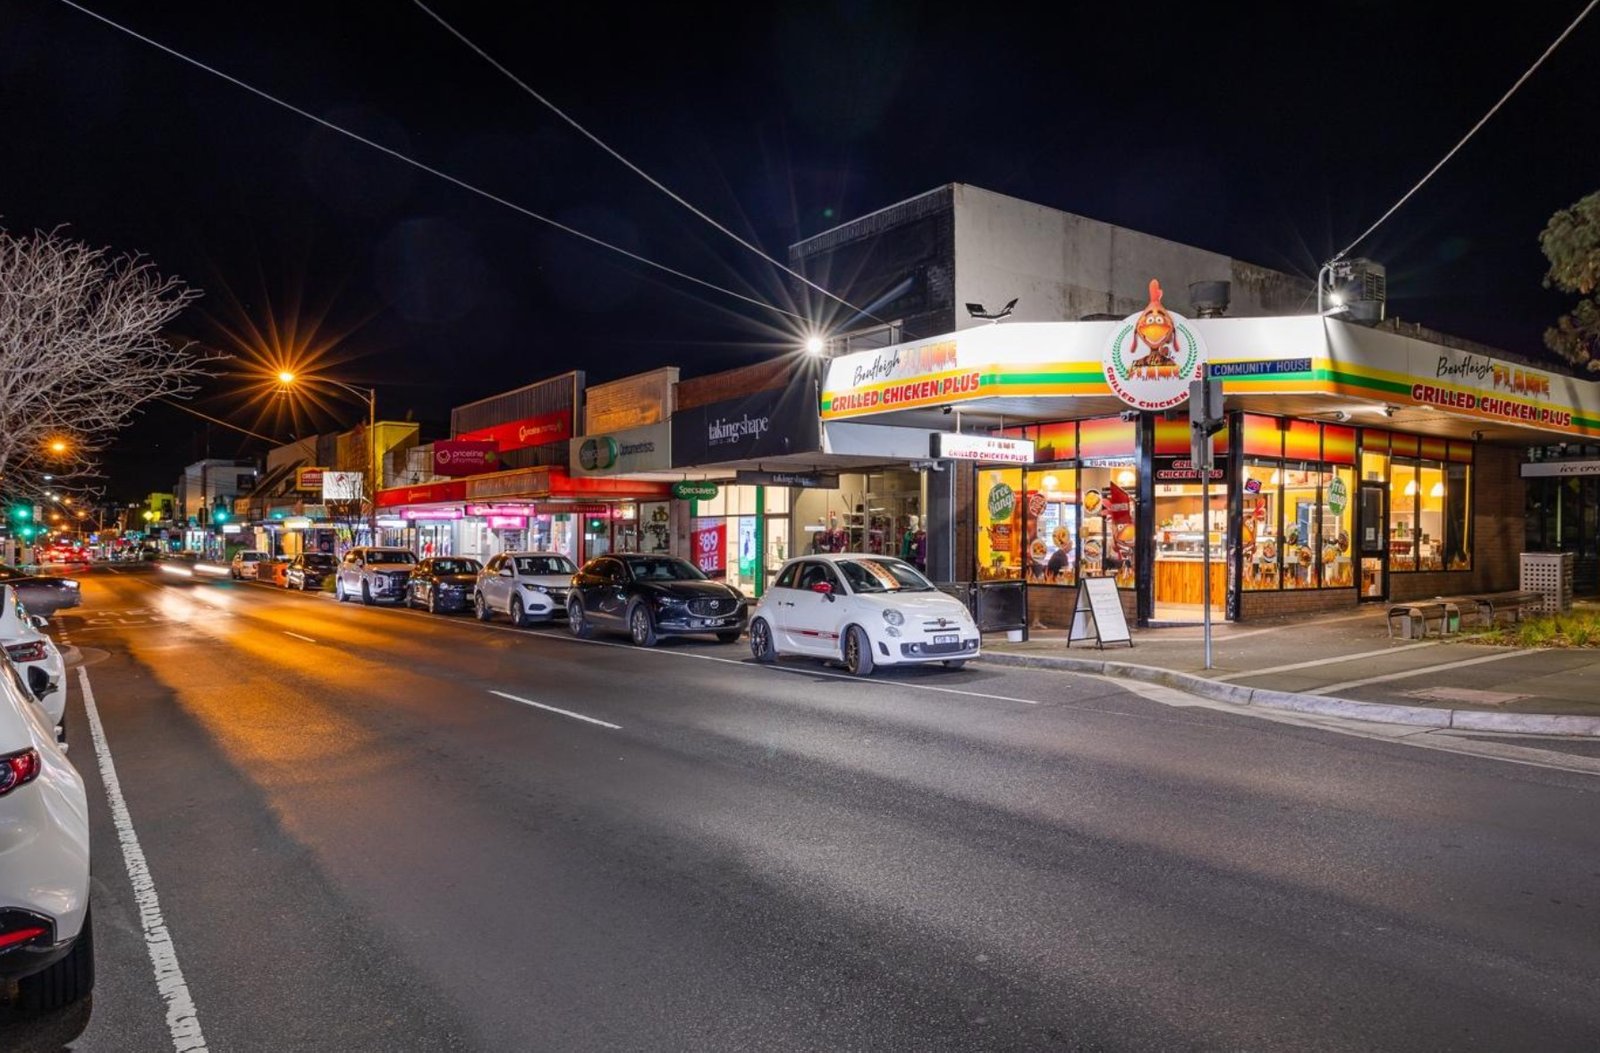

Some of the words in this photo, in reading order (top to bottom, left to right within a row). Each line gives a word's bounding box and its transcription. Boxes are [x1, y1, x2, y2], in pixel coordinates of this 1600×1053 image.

[853, 350, 900, 386] Bentleigh
[1214, 362, 1272, 376] COMMUNITY
[1276, 358, 1310, 372] HOUSE
[1436, 355, 1494, 379] Bentleigh
[832, 391, 879, 411] GRILLED
[884, 380, 939, 404] CHICKEN
[943, 373, 979, 395] PLUS
[1107, 366, 1136, 403] GRILLED
[1138, 391, 1188, 408] CHICKEN
[1412, 384, 1476, 410] GRILLED
[1480, 397, 1537, 421] CHICKEN
[1541, 409, 1570, 426] PLUS
[1158, 470, 1196, 478] CHICKEN
[679, 485, 716, 495] Specsavers
[700, 530, 718, 552] $89
[700, 556, 718, 573] SALE
